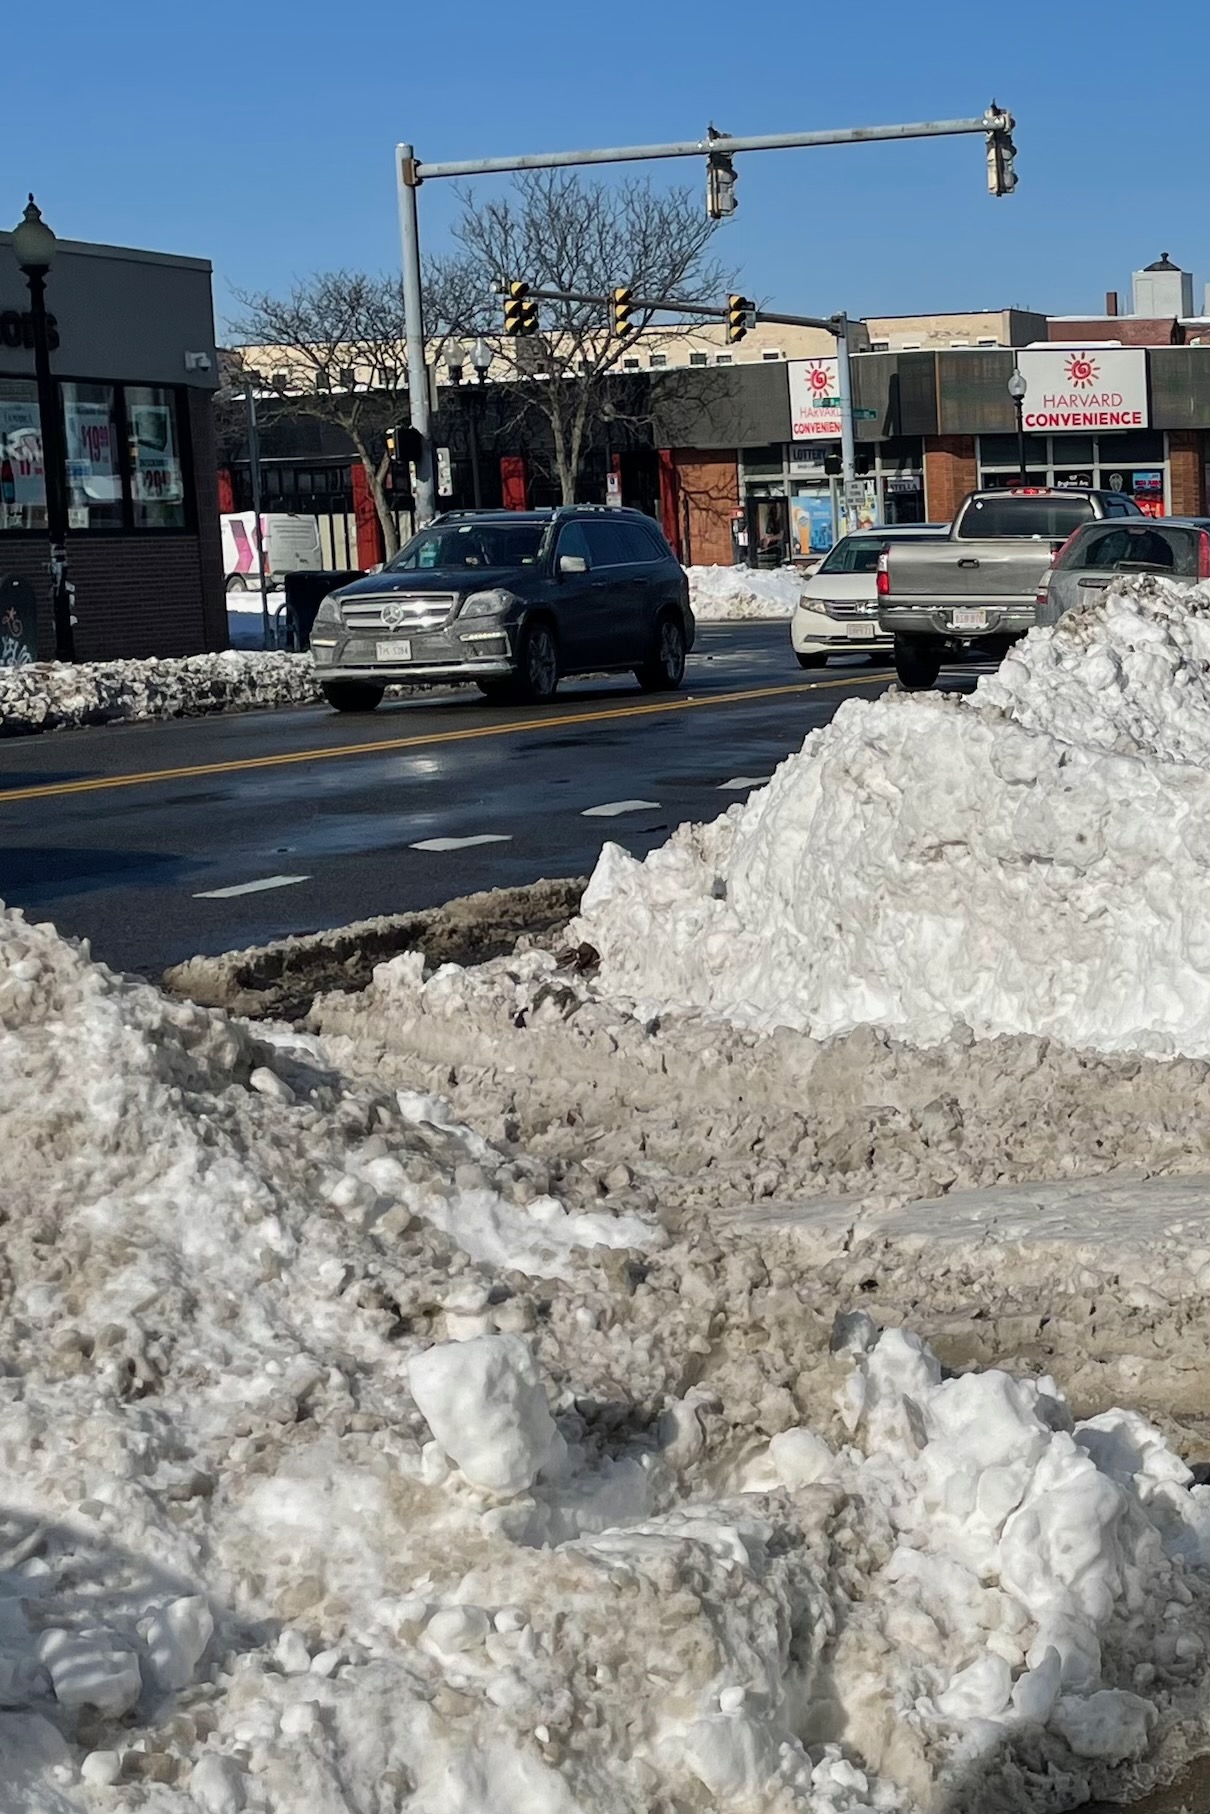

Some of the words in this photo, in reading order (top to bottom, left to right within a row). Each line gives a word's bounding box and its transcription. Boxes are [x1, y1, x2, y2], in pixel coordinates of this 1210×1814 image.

[1043, 393, 1123, 409] HARVARD
[1025, 411, 1142, 427] CONVENIENCE
[793, 422, 842, 435] CONVENIEN
[792, 448, 828, 461] LOTTERY
